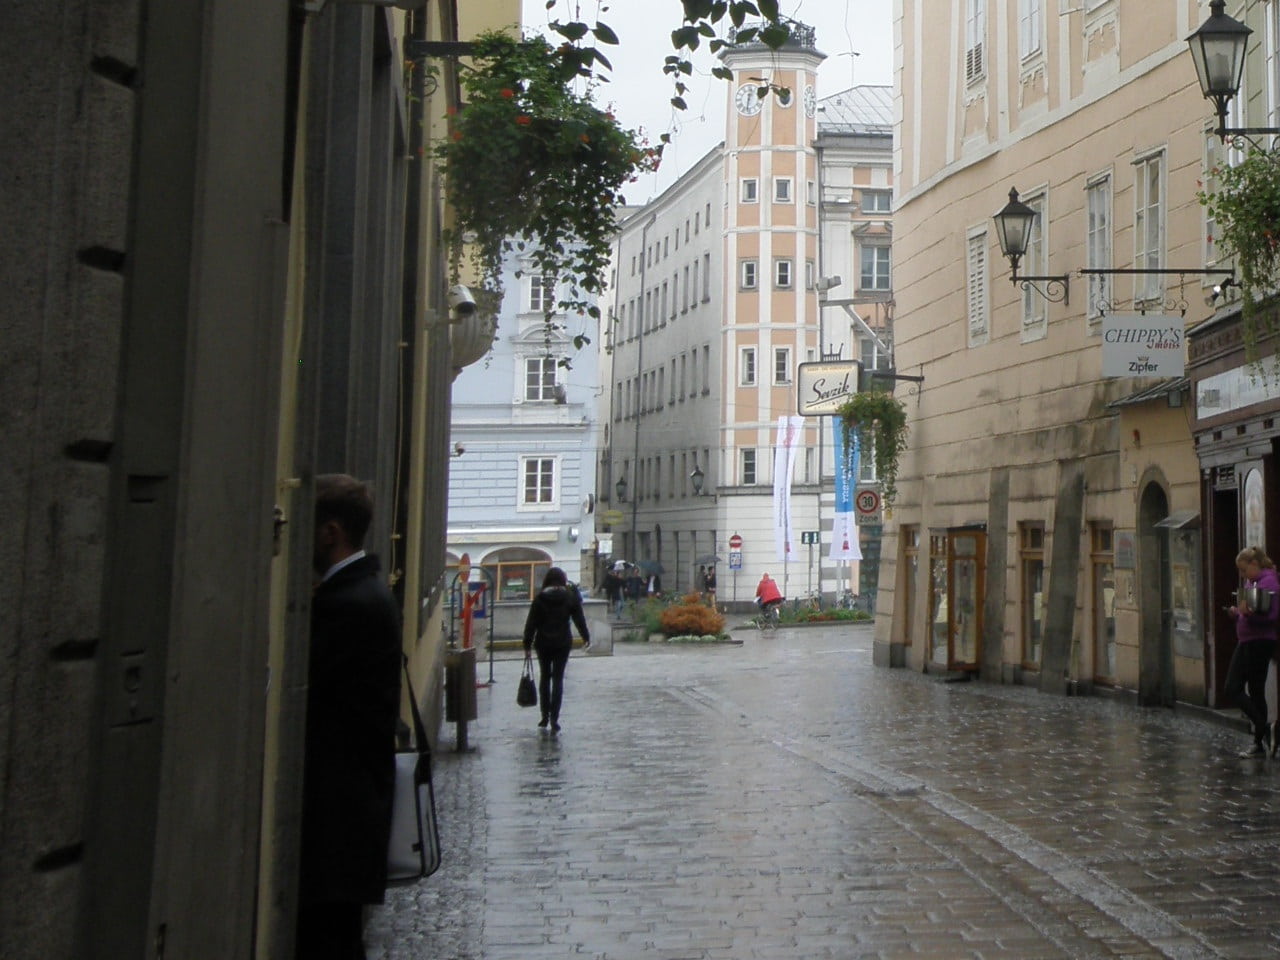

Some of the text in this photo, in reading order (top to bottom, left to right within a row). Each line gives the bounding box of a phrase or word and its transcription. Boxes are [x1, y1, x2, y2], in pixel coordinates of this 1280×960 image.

[1105, 328, 1181, 343] CHIPPY'S
[1129, 362, 1159, 375] Zipfer
[862, 496, 874, 508] 30
[859, 515, 879, 523] Zone
